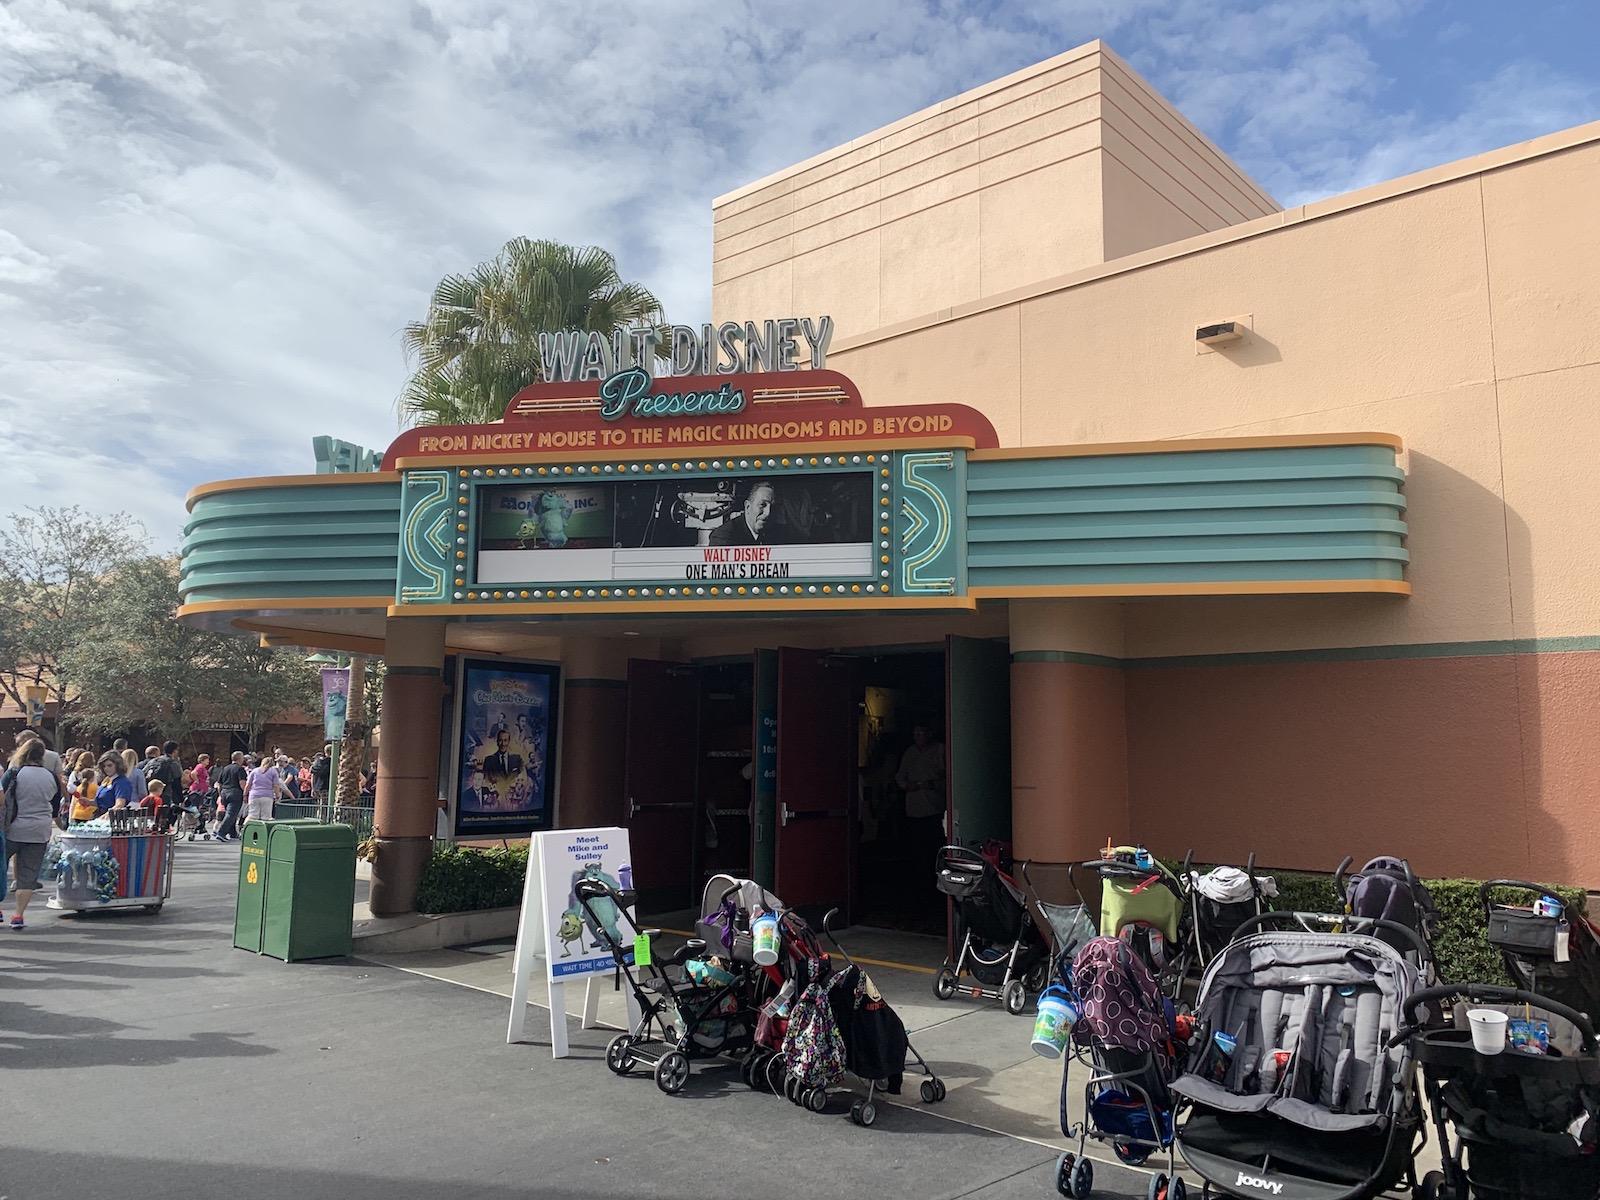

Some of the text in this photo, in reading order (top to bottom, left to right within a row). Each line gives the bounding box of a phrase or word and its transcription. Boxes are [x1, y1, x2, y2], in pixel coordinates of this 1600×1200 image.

[539, 316, 832, 383] WALT DISNEY
[601, 368, 745, 420] Presents
[419, 415, 953, 453] FROM MICKEY MOUSE TO THE MAGIC KINGDOMS AND BEYOND
[574, 497, 598, 509] INC.
[703, 547, 772, 563] WALT DISNEY
[686, 562, 789, 580] ONE MAN'S DREAM
[562, 964, 578, 972] WAIT
[1235, 1171, 1283, 1195] joovy
